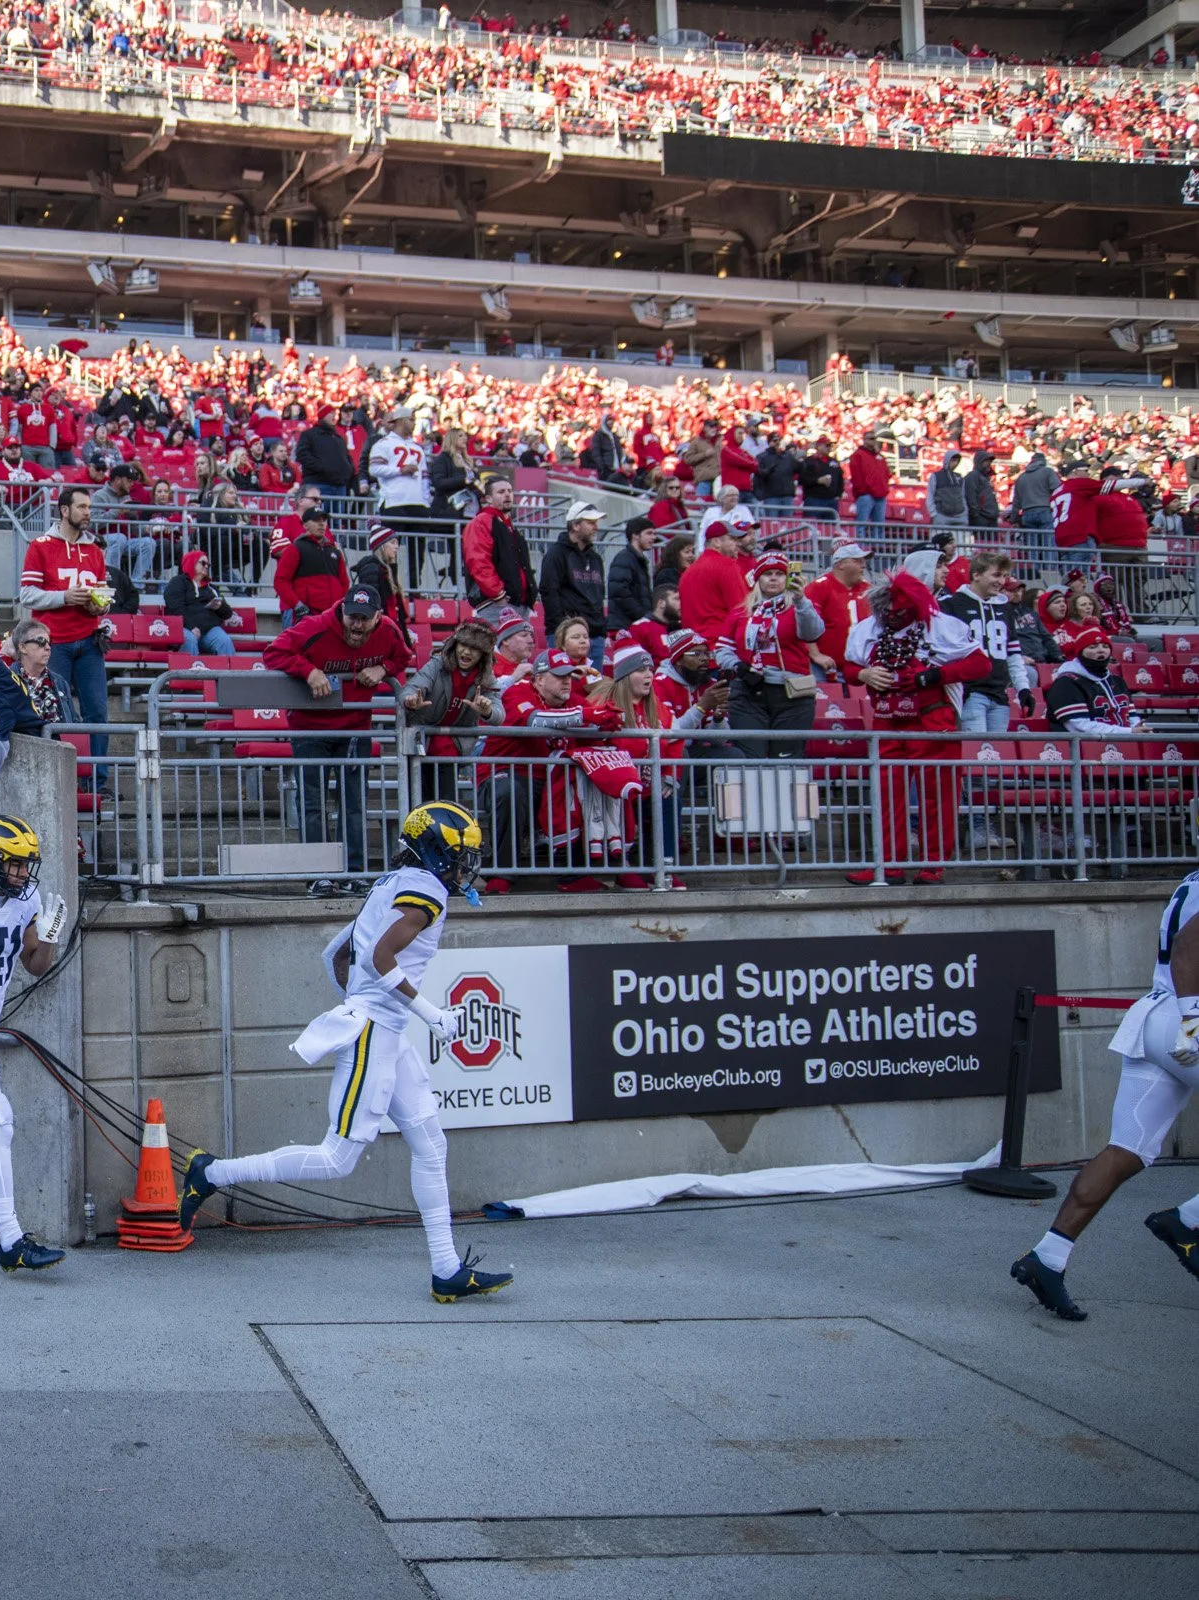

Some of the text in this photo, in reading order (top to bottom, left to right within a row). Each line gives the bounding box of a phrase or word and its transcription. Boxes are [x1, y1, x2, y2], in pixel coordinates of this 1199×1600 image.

[324, 659, 351, 672] OHIO
[613, 953, 978, 1006] Proud Supporters of
[612, 1003, 978, 1057] Ohio State Athletics
[641, 1055, 980, 1092] BuckeyeClub.org @OSUBuckeyeClub
[432, 1084, 552, 1109] CKEYE CLUB
[144, 1168, 169, 1184] OSU
